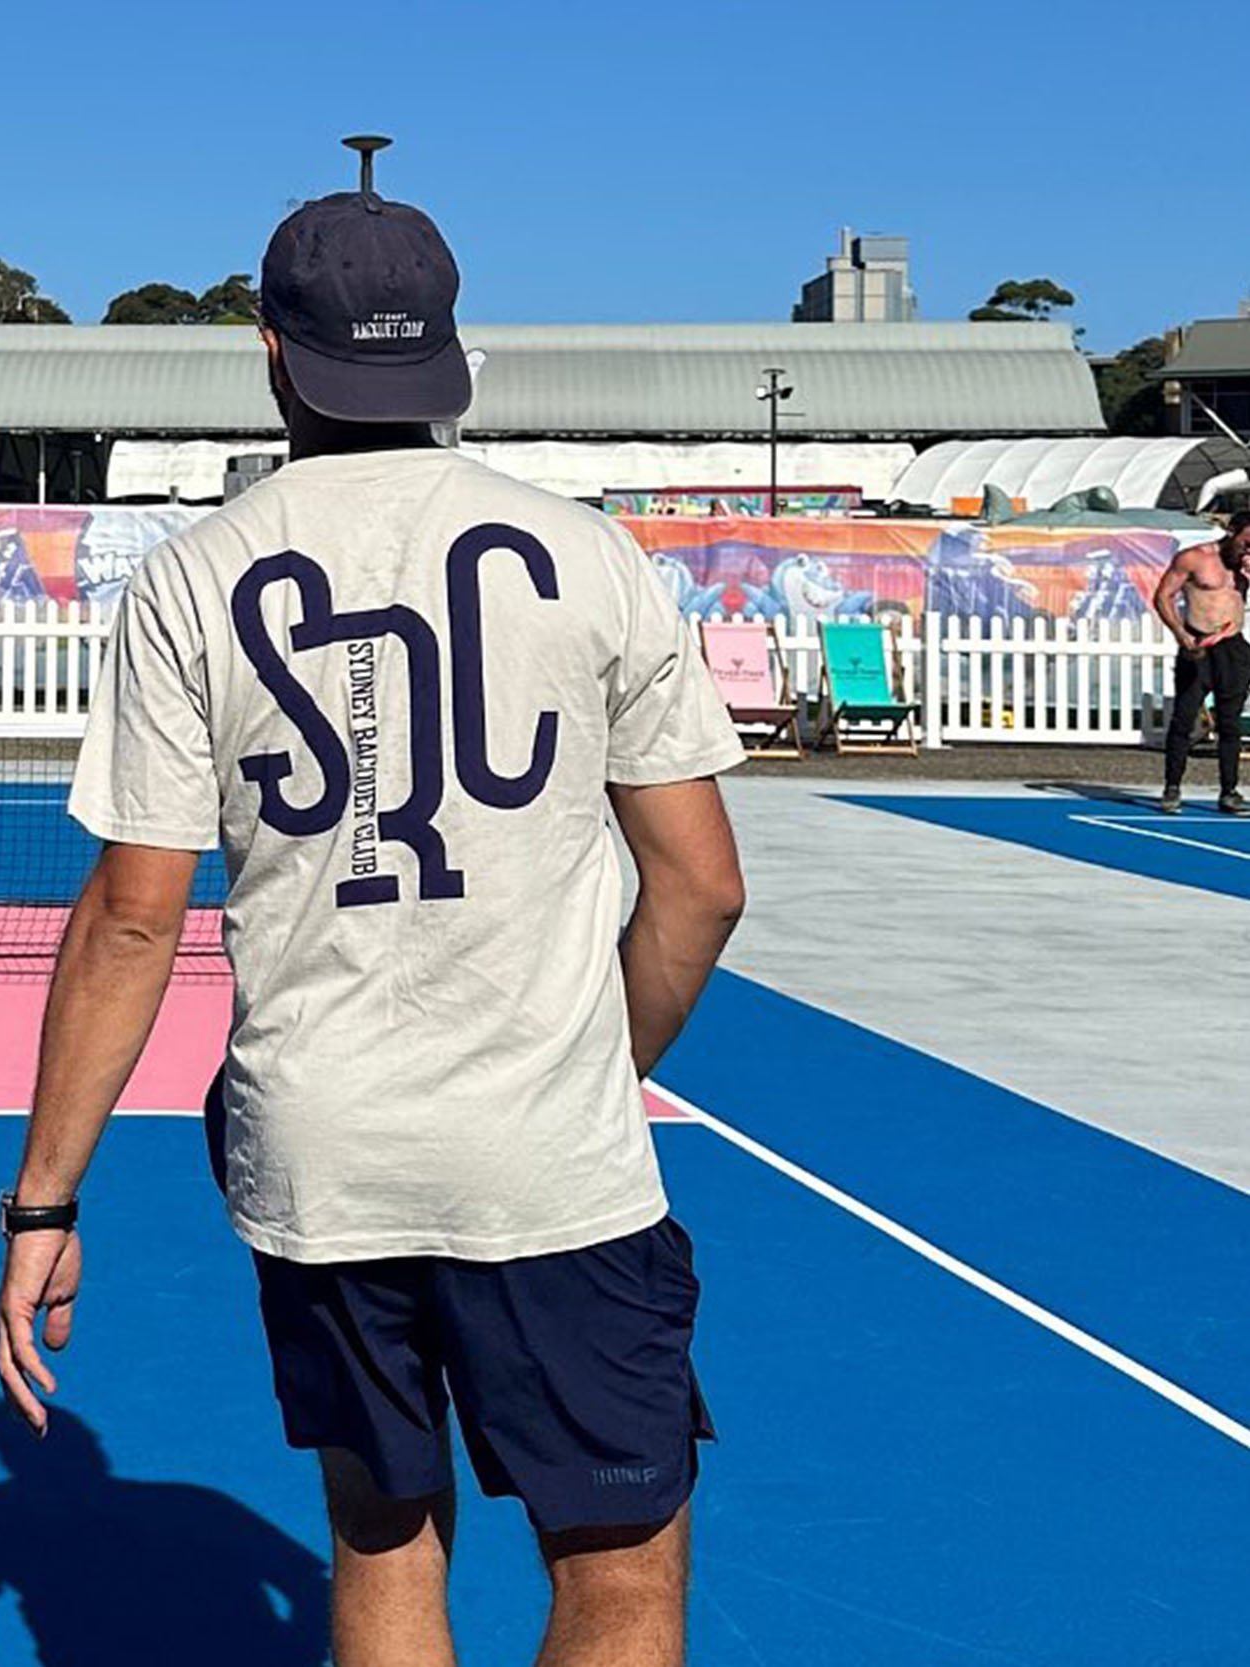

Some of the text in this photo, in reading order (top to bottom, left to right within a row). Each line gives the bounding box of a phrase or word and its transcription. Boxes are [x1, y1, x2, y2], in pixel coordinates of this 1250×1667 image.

[347, 641, 378, 876] SYDNEY RACQUET CLUB
